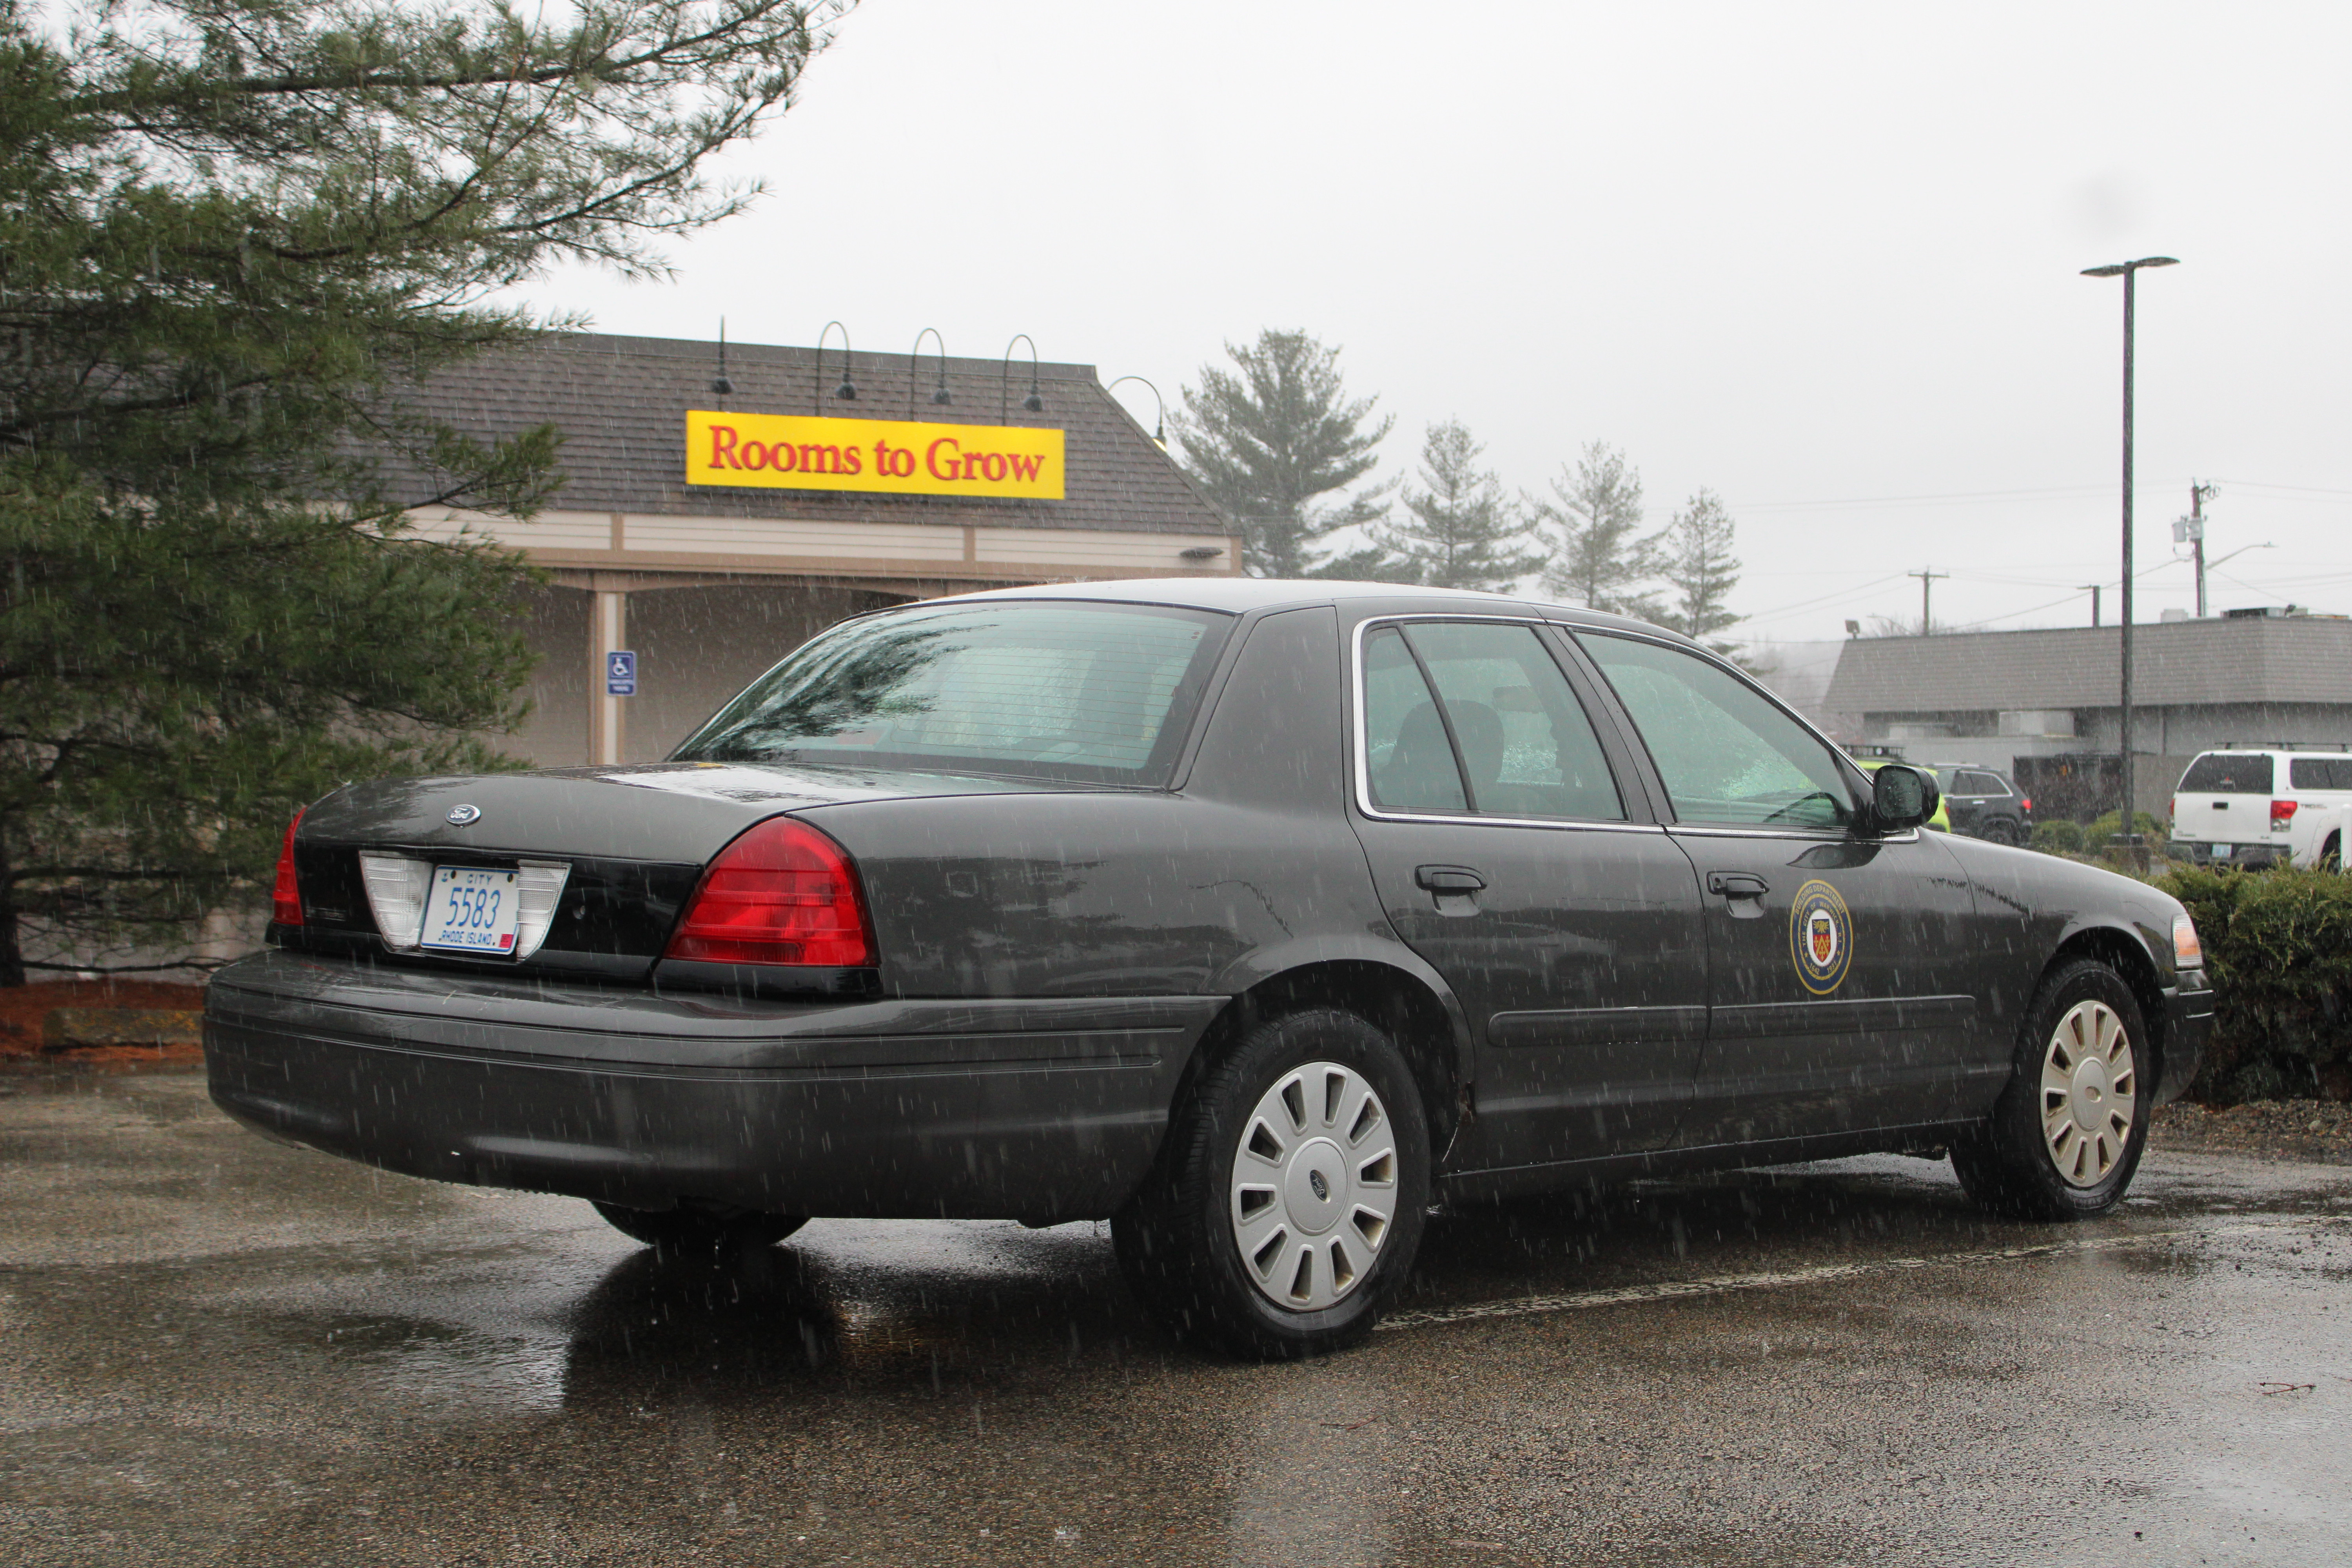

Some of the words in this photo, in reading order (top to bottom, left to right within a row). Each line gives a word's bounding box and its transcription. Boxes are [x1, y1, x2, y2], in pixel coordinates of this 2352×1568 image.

[708, 425, 862, 475] Rooms
[875, 439, 916, 477] to
[926, 437, 1045, 482] Grow
[450, 808, 471, 819] Ford
[466, 874, 493, 884] CITY
[445, 887, 501, 929] 5583
[1795, 886, 1813, 915] BUILDING
[1813, 885, 1845, 914] DEPARTMENT
[441, 930, 465, 943] RHODE
[466, 932, 492, 945] ISLAND
[1809, 963, 1820, 975] 1642
[1827, 960, 1837, 974] 1931
[1312, 1178, 1325, 1195] Ford
